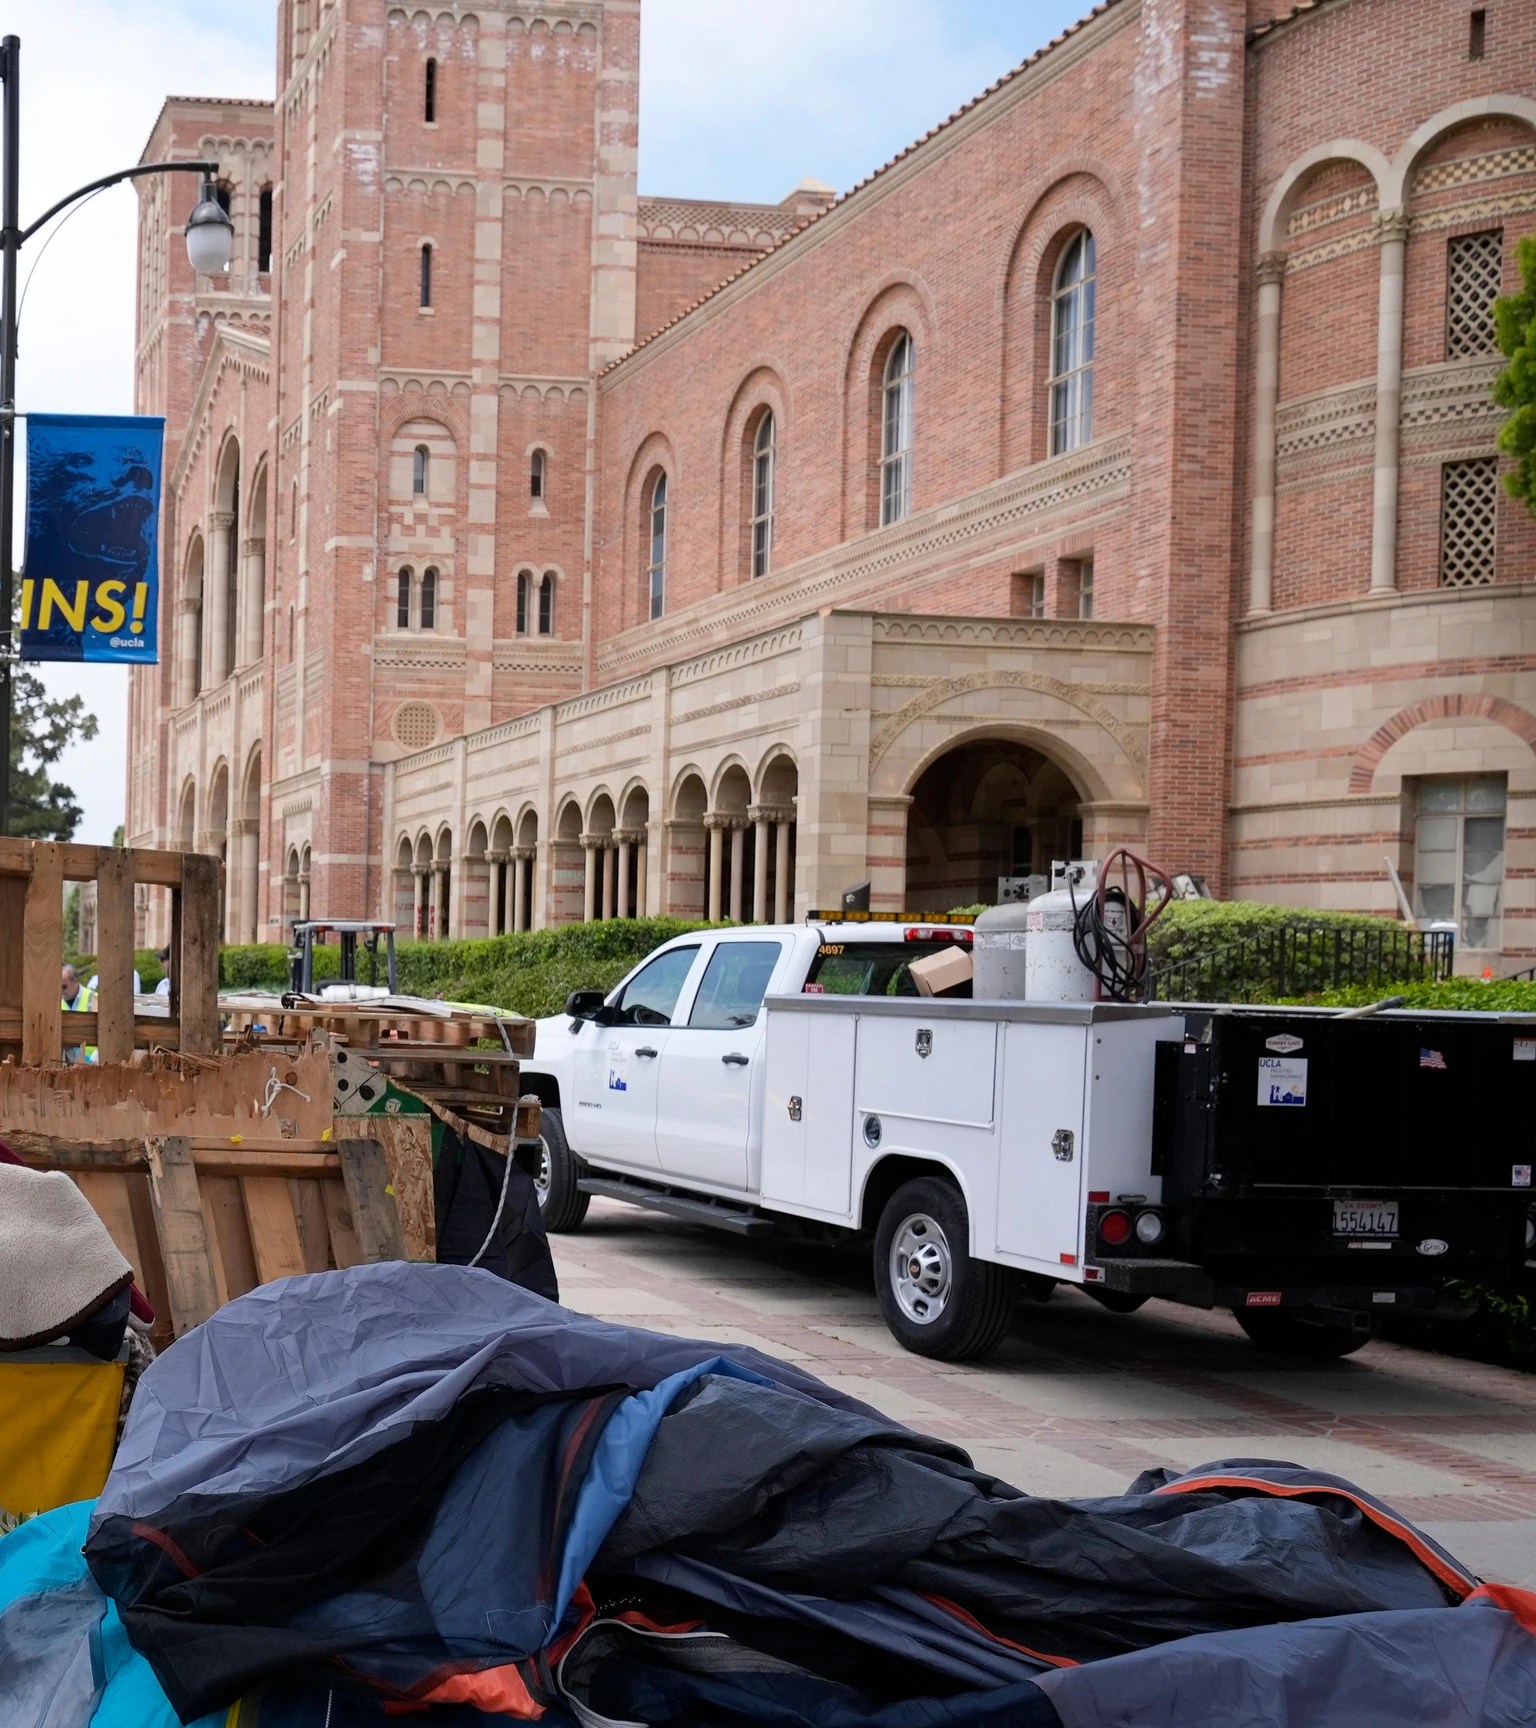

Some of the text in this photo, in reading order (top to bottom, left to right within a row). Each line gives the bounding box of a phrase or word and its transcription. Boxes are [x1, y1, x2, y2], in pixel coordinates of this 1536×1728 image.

[110, 636, 145, 648] @ucla
[819, 944, 844, 955] 4697
[1259, 1059, 1282, 1068] UCLA
[1333, 1211, 1396, 1232] 1554147
[1248, 1295, 1279, 1303] ACME
